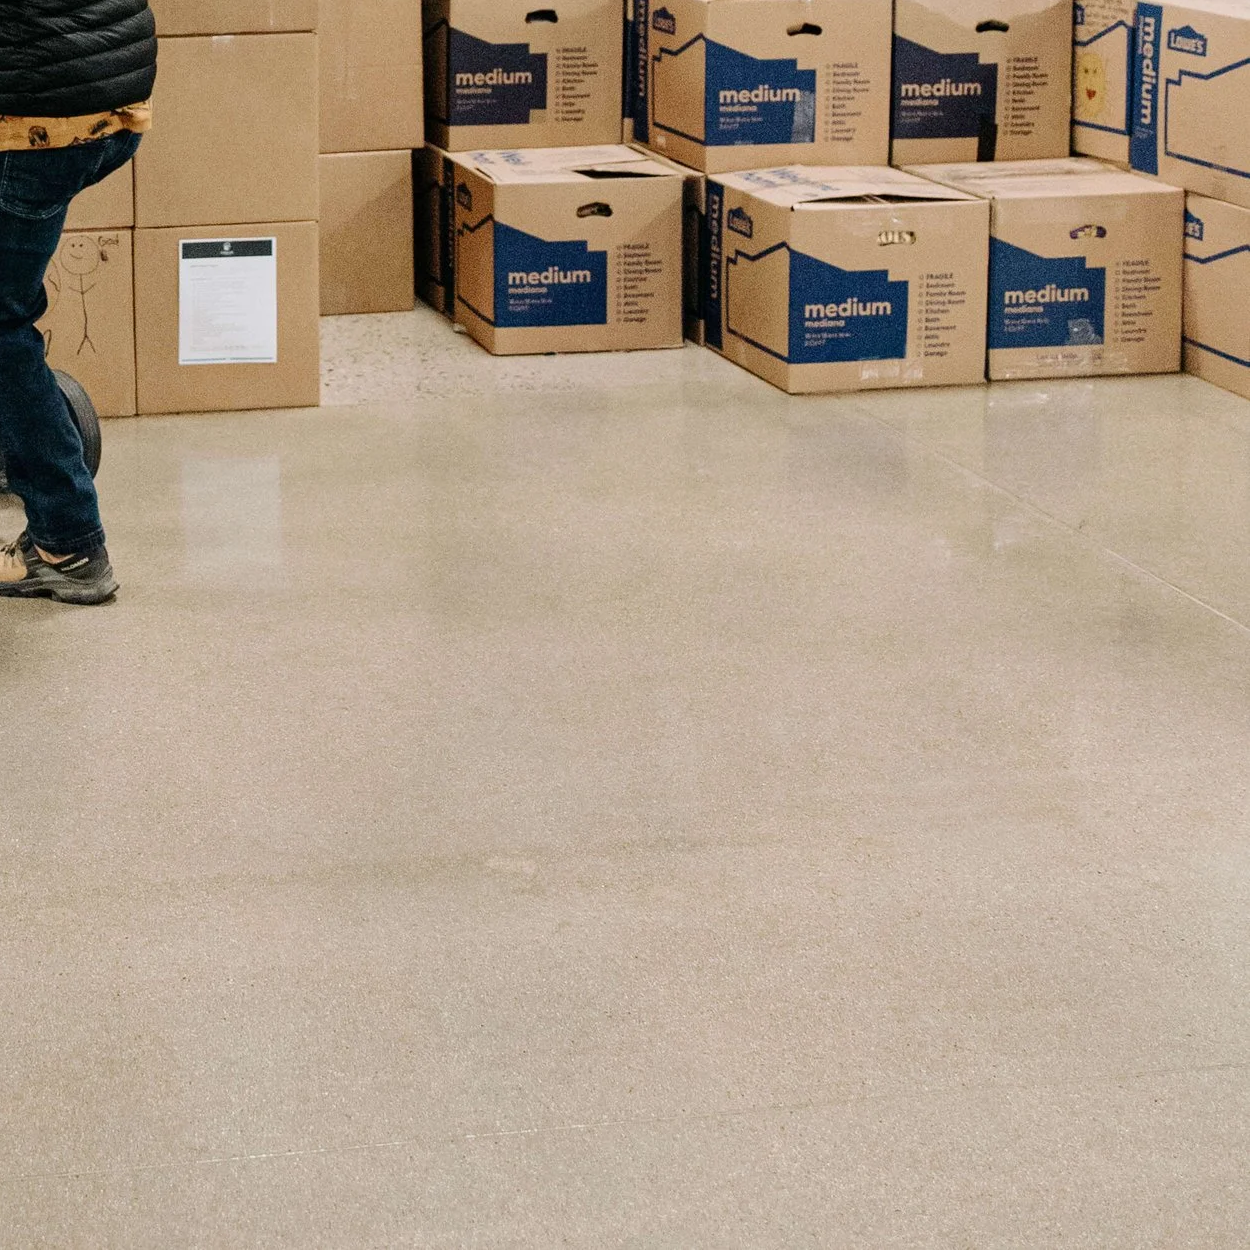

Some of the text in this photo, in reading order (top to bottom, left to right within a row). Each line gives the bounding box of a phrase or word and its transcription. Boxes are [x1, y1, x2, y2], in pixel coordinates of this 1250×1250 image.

[455, 68, 533, 86] medium
[1141, 17, 1156, 125] medium
[719, 84, 801, 103] medium
[901, 78, 982, 97] medium
[508, 265, 591, 285] medium
[1004, 284, 1089, 304] medium
[804, 297, 892, 318] medium
